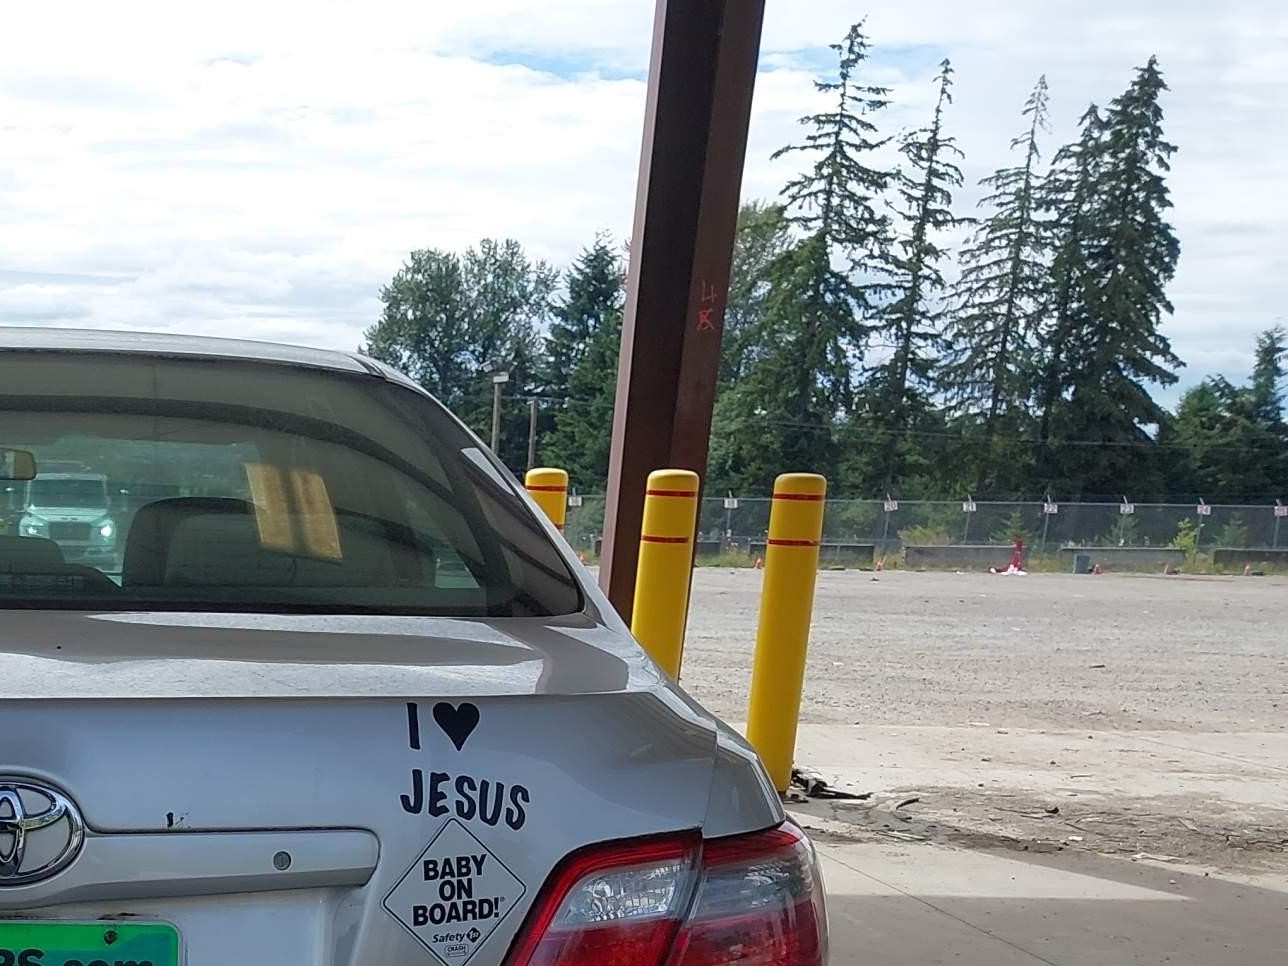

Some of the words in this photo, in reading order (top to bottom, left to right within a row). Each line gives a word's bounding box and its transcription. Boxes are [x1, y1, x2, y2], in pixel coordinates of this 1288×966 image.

[406, 702, 421, 750] I
[400, 769, 530, 831] JESUS
[423, 854, 487, 881] BABY
[439, 878, 473, 902] ON
[413, 897, 500, 926] BOARD!
[432, 931, 465, 943] Safety
